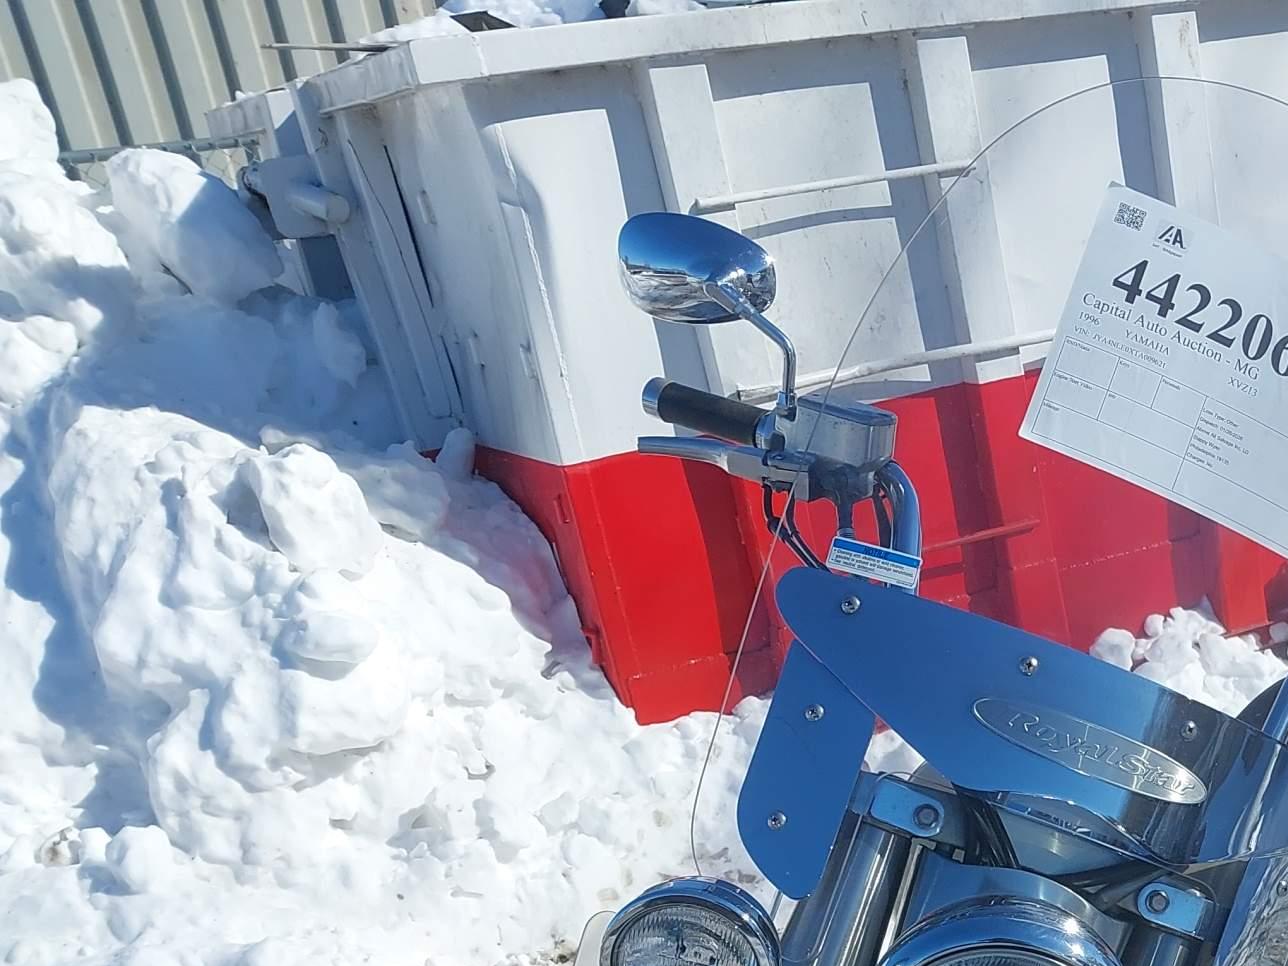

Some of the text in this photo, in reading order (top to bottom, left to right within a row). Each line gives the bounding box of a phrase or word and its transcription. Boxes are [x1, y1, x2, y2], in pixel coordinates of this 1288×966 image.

[1074, 325, 1091, 336] VIN:
[1079, 311, 1258, 397] 1996 YAMAHA XVZ13
[1083, 292, 1132, 321] Capital
[1134, 314, 1168, 337] Auto
[1171, 330, 1222, 362] Auction
[1234, 358, 1260, 380] MG
